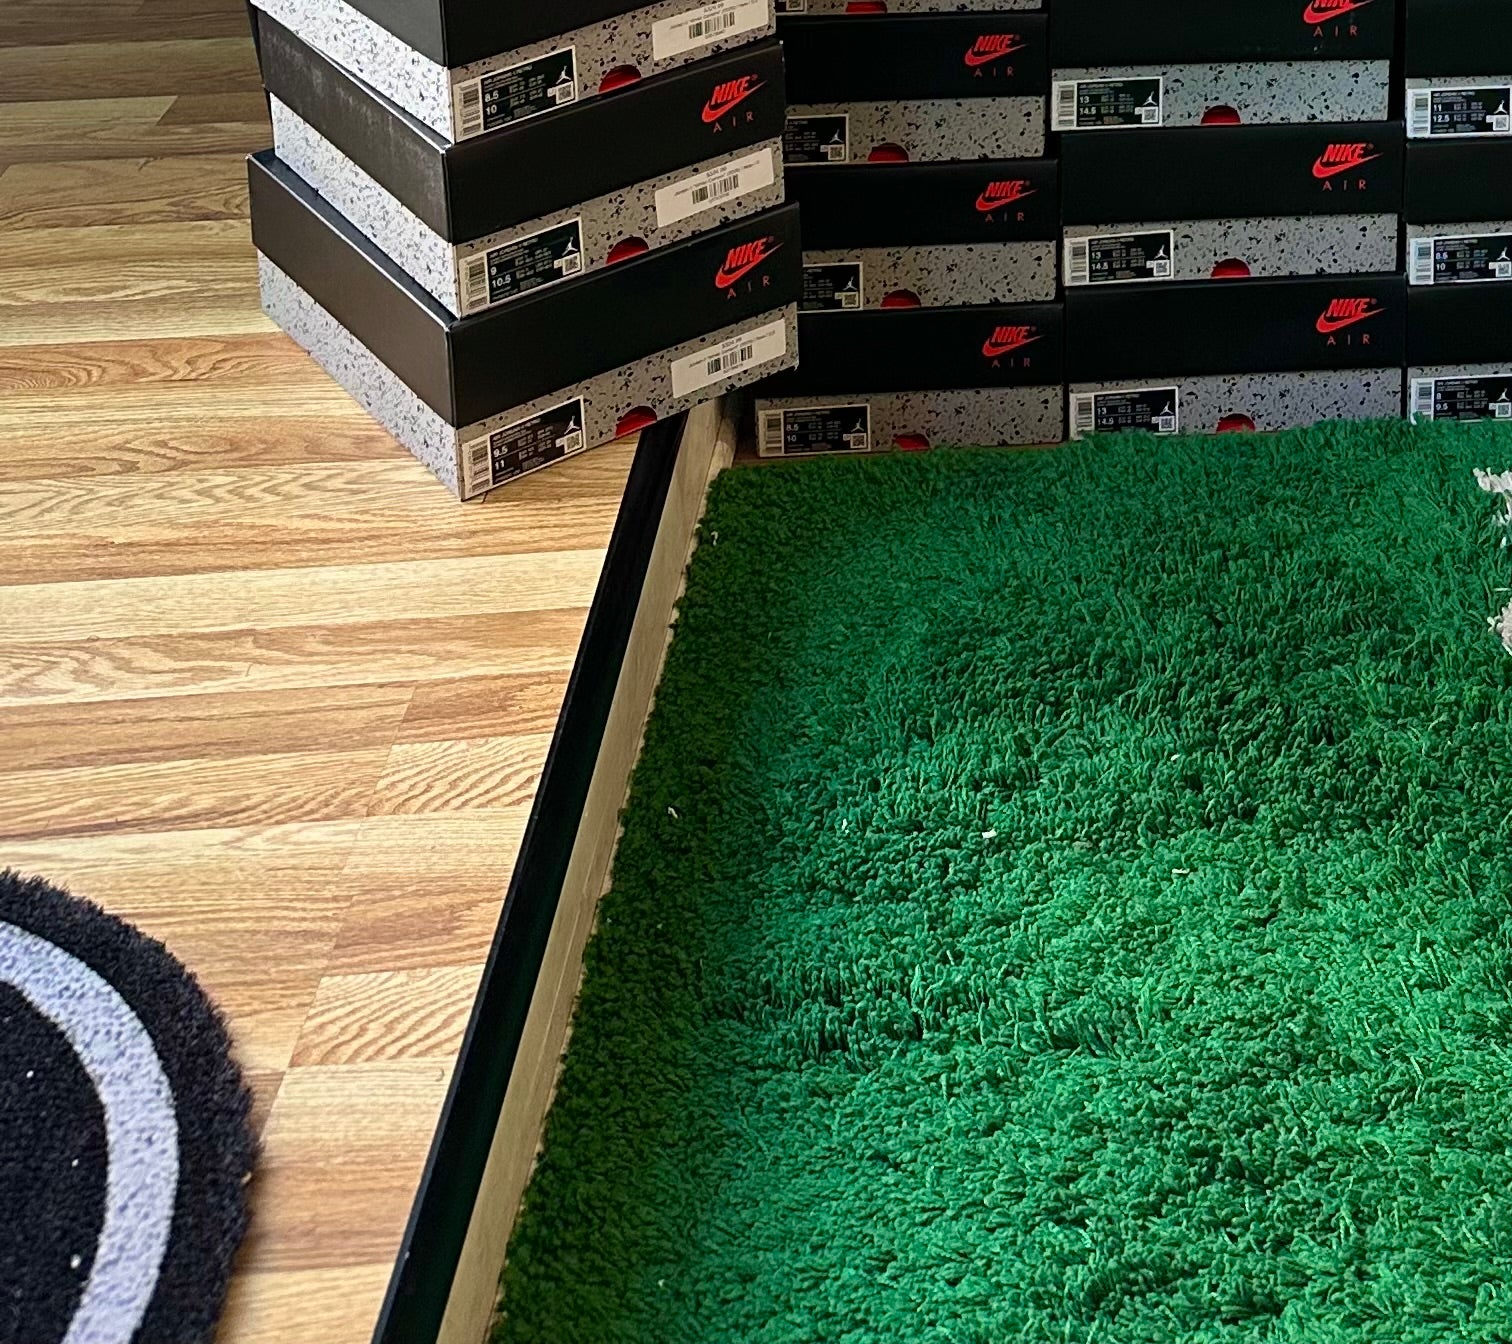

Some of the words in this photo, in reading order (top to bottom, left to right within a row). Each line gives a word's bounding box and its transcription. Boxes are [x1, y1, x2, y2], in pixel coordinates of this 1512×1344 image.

[1313, 24, 1359, 37] AIR
[974, 35, 1015, 52] NIKE
[973, 66, 1016, 78] AIR
[485, 90, 499, 104] 8.5
[711, 76, 752, 106] NIKE
[486, 103, 498, 116] 10
[713, 111, 755, 133] AIR
[1320, 143, 1367, 163] NIKE
[985, 181, 1025, 198] NIKE
[1321, 179, 1367, 192] AIR
[984, 212, 1025, 223] AIR
[724, 238, 769, 272] NIKE
[490, 265, 498, 277] 9
[492, 273, 512, 288] 10.5
[727, 274, 772, 300] AIR
[1325, 298, 1371, 317] NIKE
[991, 327, 1031, 344] NIKE
[1326, 333, 1371, 346] AIR
[991, 358, 1032, 368] AIR
[495, 459, 505, 471] 11
